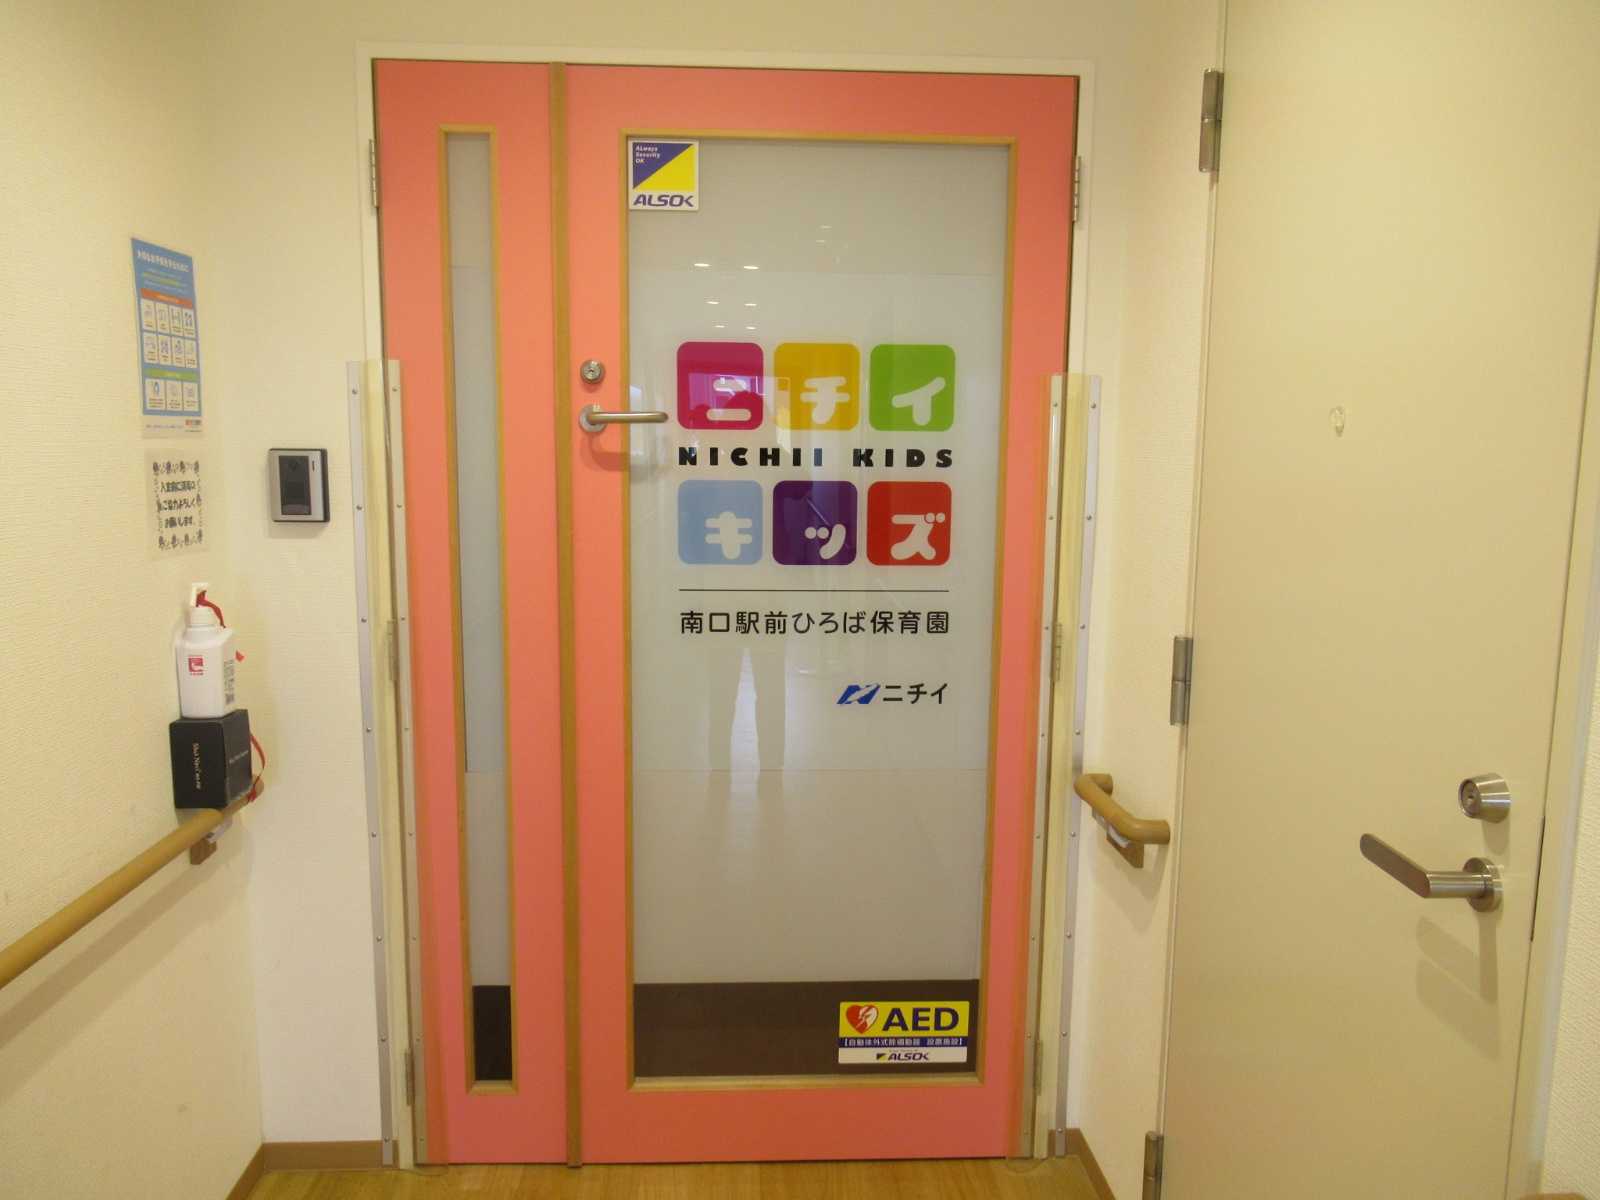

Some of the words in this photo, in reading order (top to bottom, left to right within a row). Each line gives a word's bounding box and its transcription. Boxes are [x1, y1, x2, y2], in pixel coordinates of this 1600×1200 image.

[633, 194, 694, 207] ALSOK
[678, 447, 823, 467] NICHII
[852, 448, 953, 468] KIDS
[702, 508, 949, 562] キッズ
[679, 610, 950, 635] 南口駅前ひろば保育園
[882, 682, 949, 705] ニチイ
[882, 1007, 960, 1032] AED
[888, 1052, 929, 1061] ALSOK
